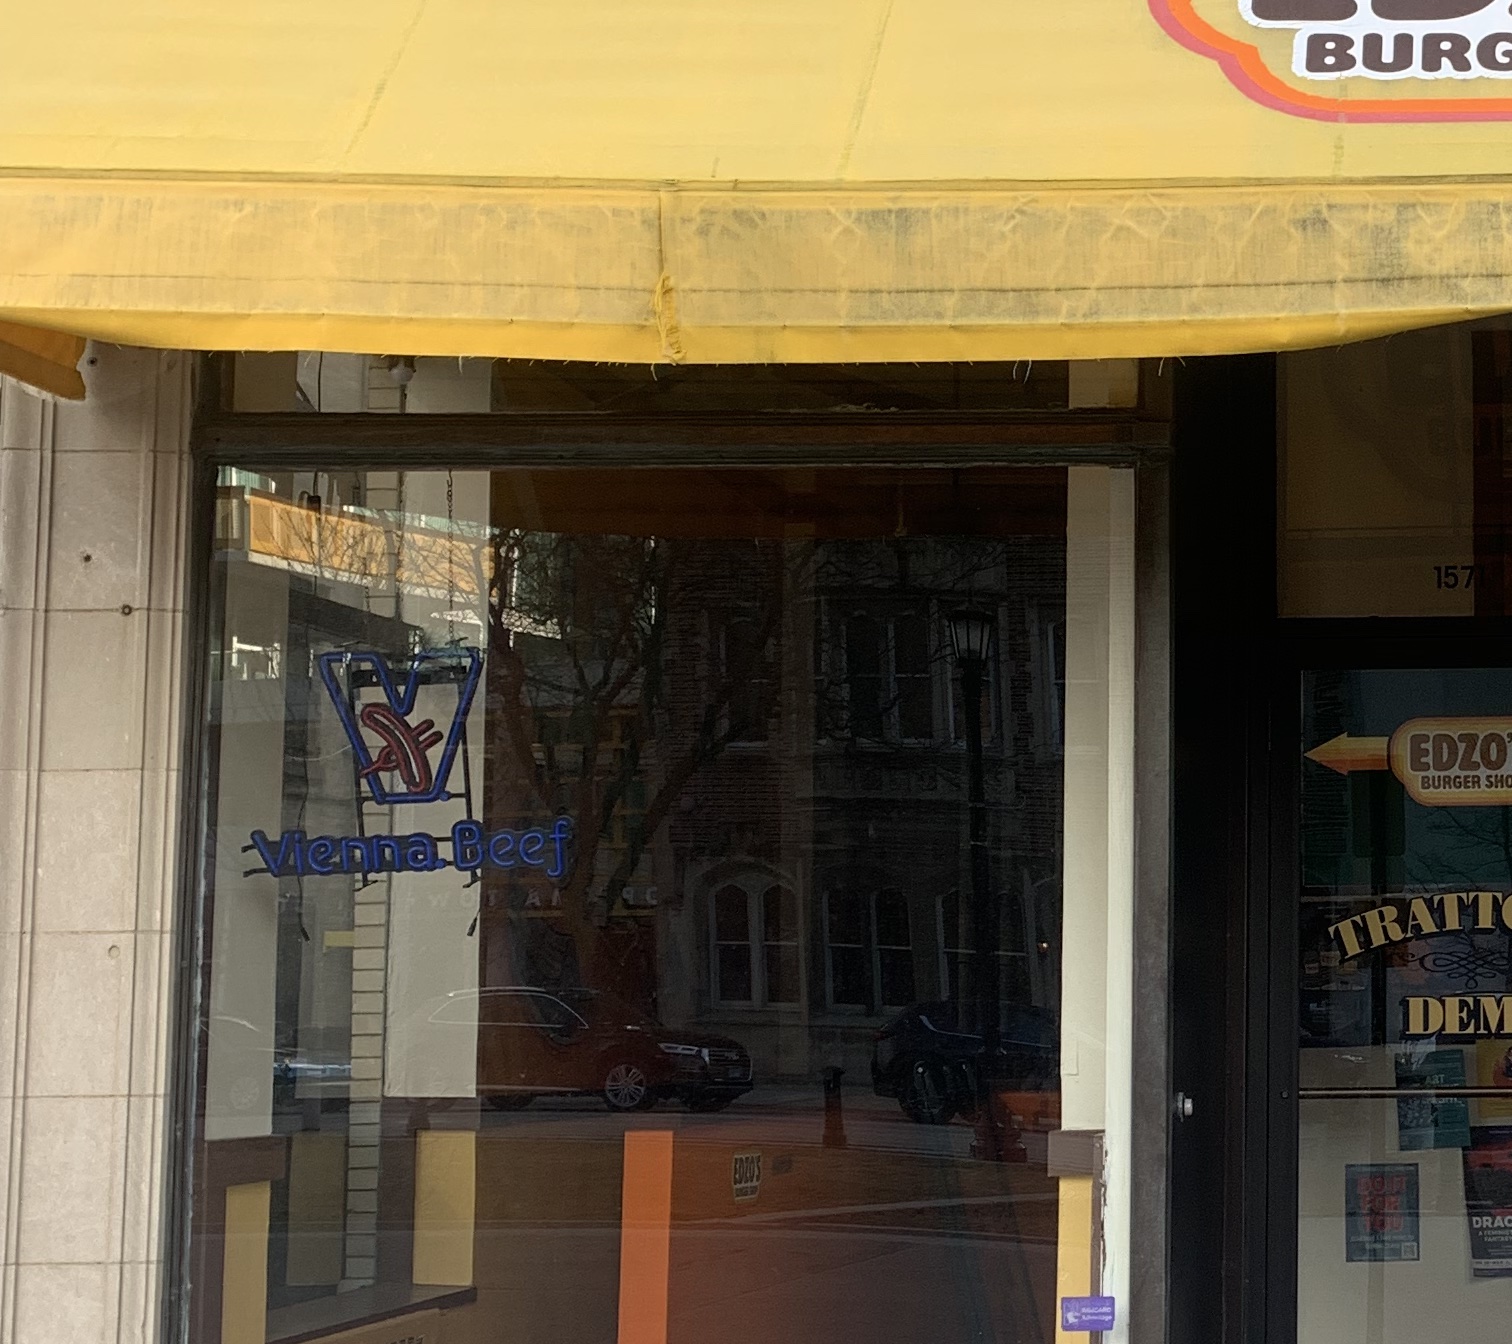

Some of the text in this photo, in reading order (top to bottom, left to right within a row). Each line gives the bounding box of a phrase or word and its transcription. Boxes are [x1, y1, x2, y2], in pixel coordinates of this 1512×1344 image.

[1420, 775, 1481, 791] BURGER
[250, 817, 573, 879] Vienna Beef
